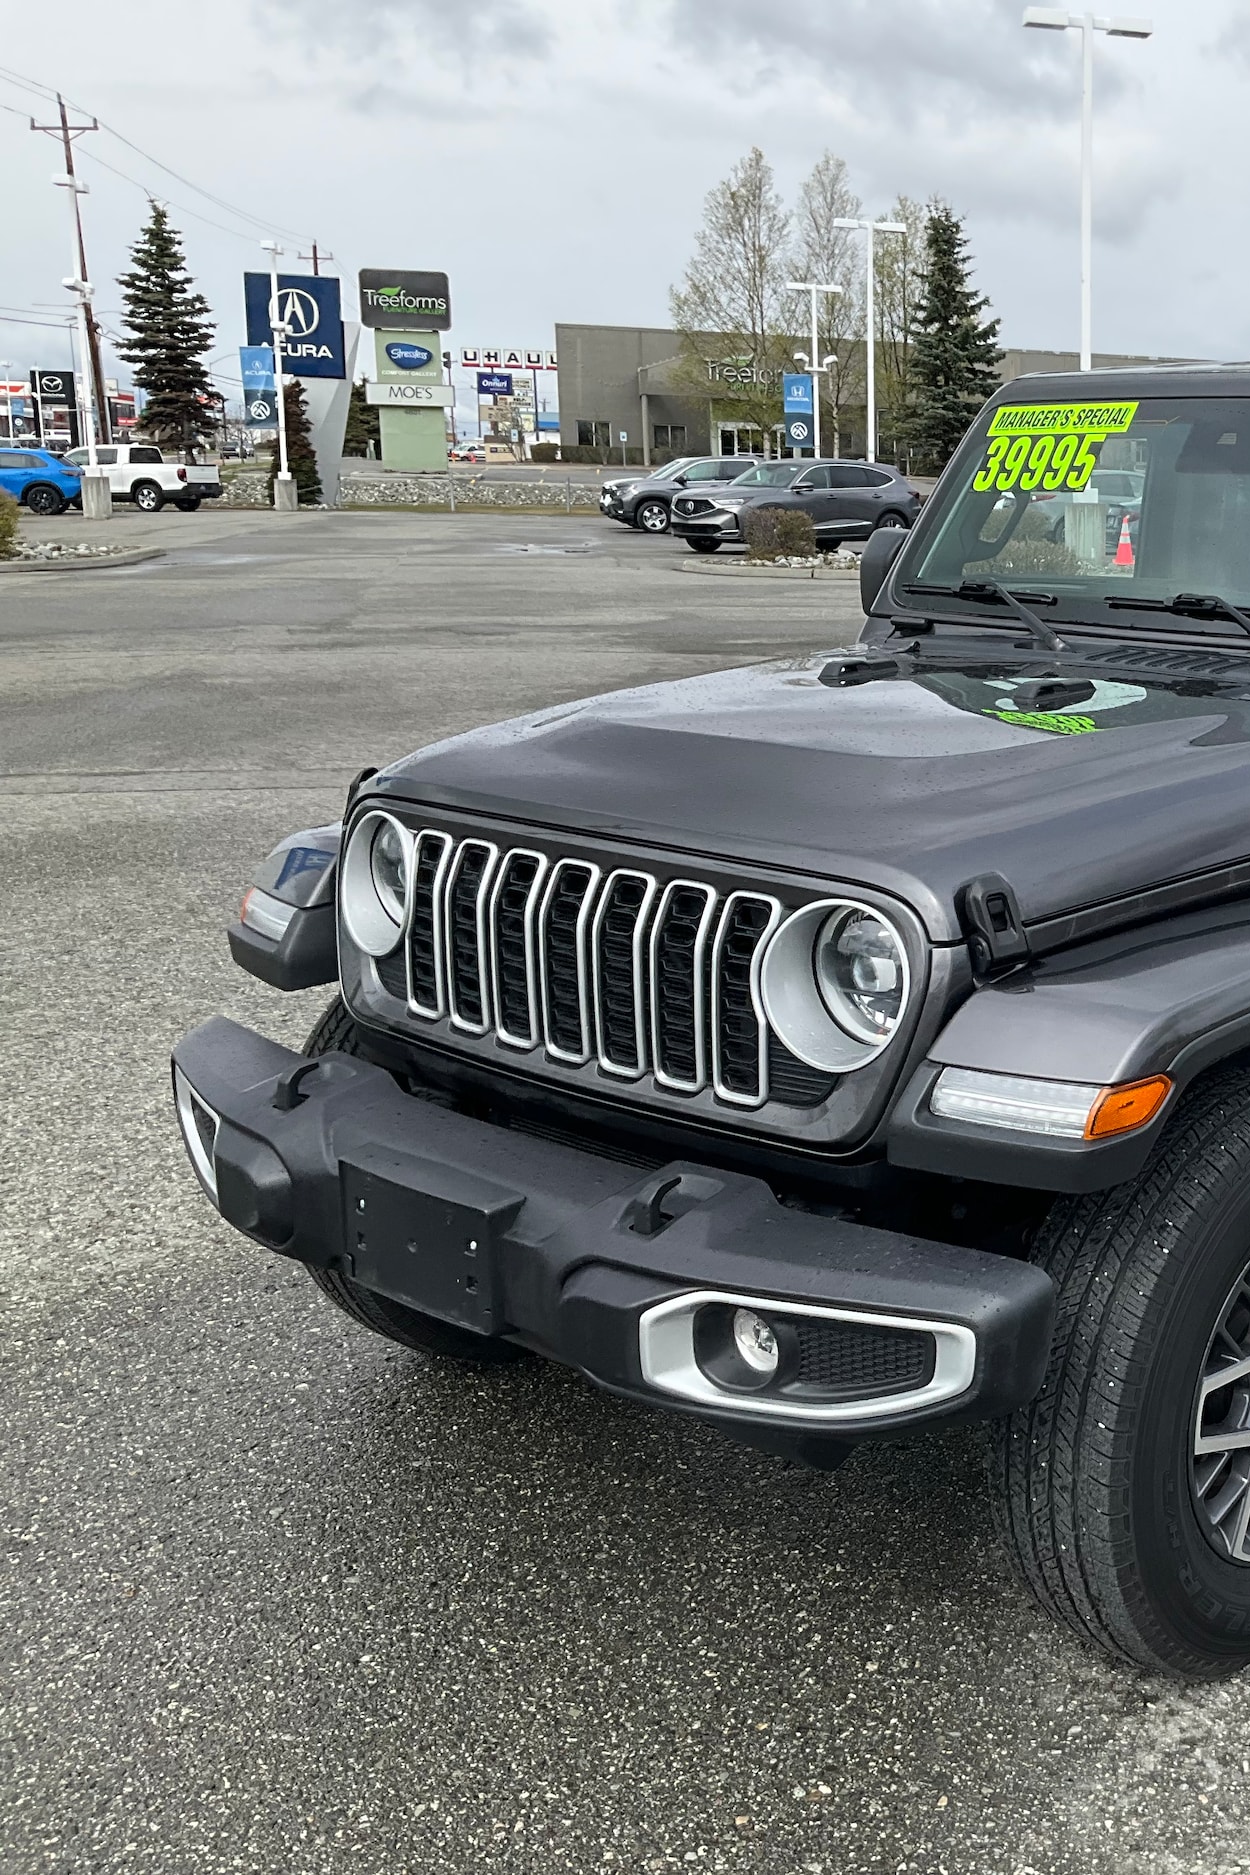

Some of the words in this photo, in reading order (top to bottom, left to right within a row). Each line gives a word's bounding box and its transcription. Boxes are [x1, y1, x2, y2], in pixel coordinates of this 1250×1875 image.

[362, 289, 447, 310] Treeforms
[390, 348, 428, 360] Stressless
[703, 358, 784, 384] Treefor
[388, 385, 433, 400] MOE'S
[995, 408, 1074, 430] MANAGER'S
[1073, 407, 1130, 428] SPECIAL
[972, 433, 1107, 492] 39995
